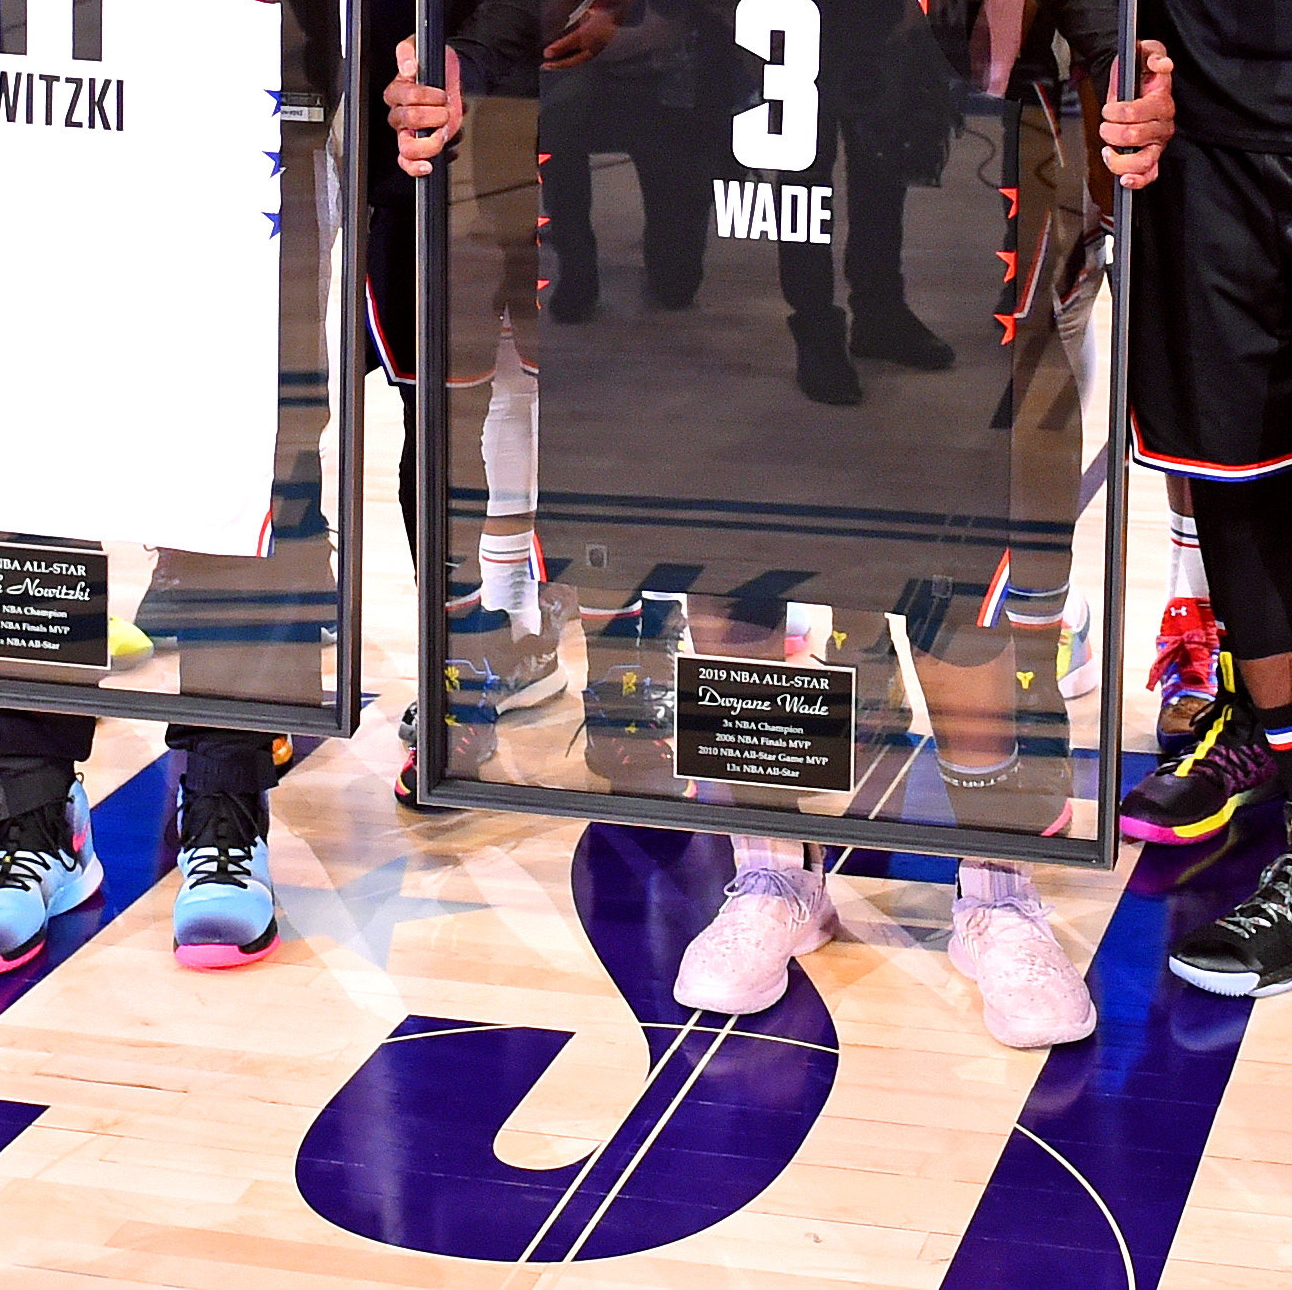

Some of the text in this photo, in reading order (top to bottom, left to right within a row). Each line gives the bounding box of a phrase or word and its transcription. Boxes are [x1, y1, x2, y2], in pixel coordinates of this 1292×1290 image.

[712, 179, 834, 245] WADE
[23, 561, 87, 577] ALL-STAR
[6, 577, 91, 601] Nowitzki
[2, 605, 23, 615] NBA
[23, 607, 68, 620] Champion
[0, 620, 21, 631] NBA
[21, 623, 48, 633] Finals
[48, 624, 71, 635] MVP
[6, 637, 27, 648] NBA
[27, 639, 61, 651] All-Star
[698, 667, 830, 690] 2019 NBA ALL-STAR
[697, 685, 830, 716] Dwyane Wade
[722, 719, 804, 736] 3x NBA Champion
[715, 733, 812, 750] 2006 NBA Finals MVP
[697, 746, 830, 766] 2010 NBA All-Star Game MVP
[726, 763, 801, 778] 13x NBA All-Star
